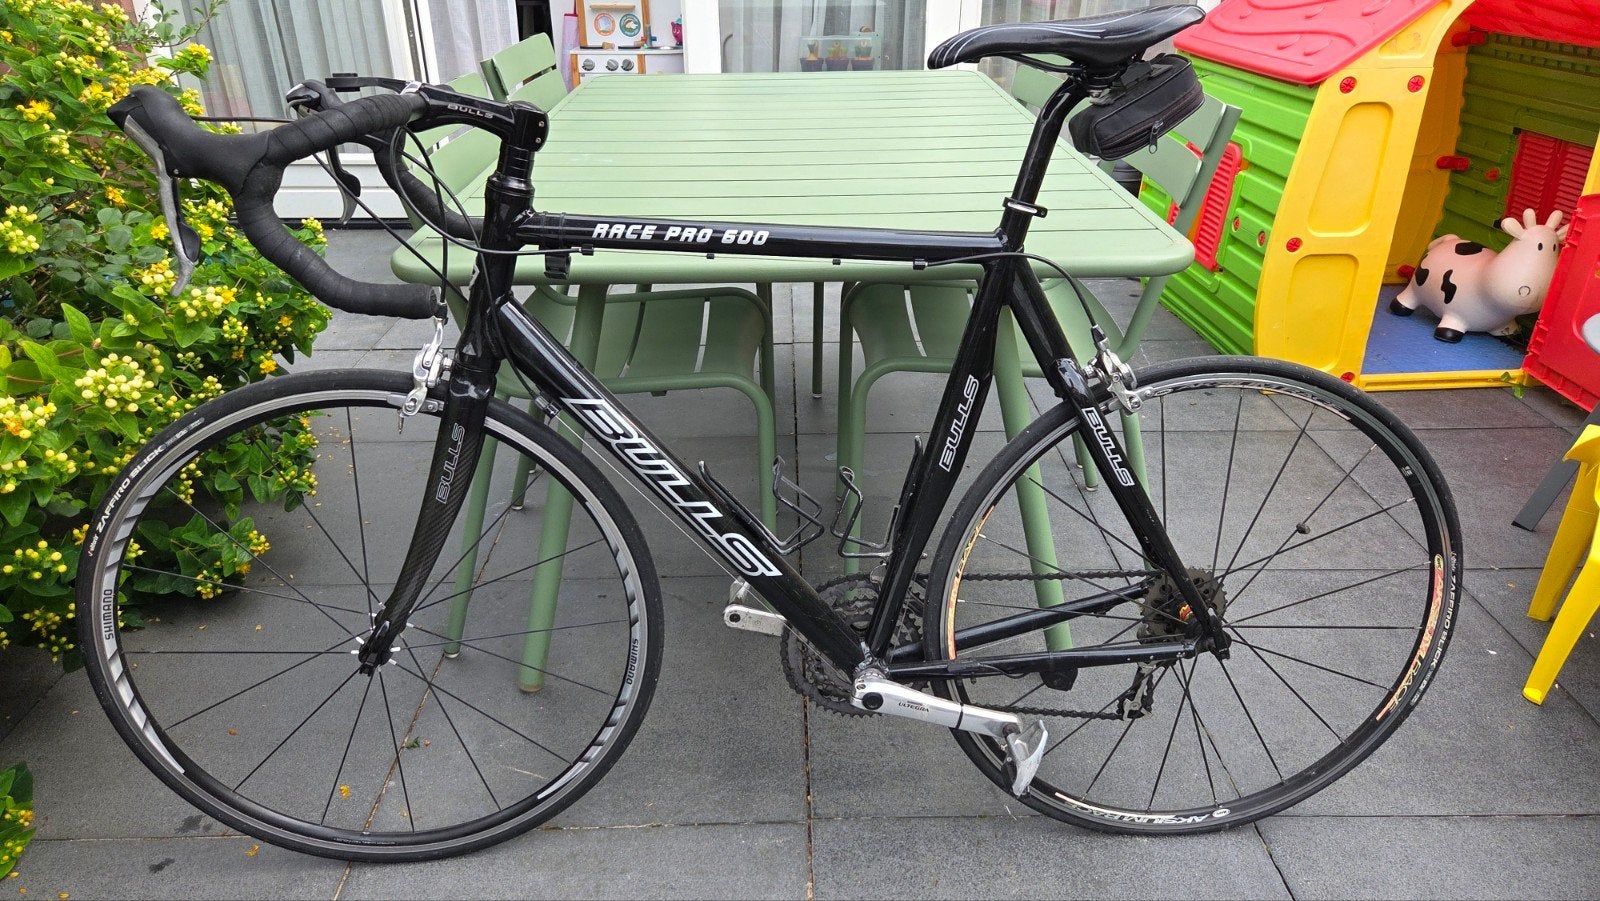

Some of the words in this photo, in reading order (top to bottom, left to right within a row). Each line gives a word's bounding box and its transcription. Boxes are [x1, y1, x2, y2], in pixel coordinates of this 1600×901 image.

[447, 103, 494, 119] BULLS
[591, 223, 658, 240] RACE
[663, 226, 714, 243] PRO
[721, 229, 770, 246] 600
[939, 374, 980, 472] BULLS
[1081, 406, 1135, 487] BULLS
[96, 477, 132, 533] ZAFFIRO
[130, 443, 167, 479] SLICK
[436, 422, 466, 504] BULLS
[559, 397, 784, 578] BULLS
[102, 589, 115, 641] SHIMANO
[1444, 575, 1456, 630] ZAFFIRO
[626, 638, 639, 685] SHIMANO
[1430, 629, 1450, 669] SLICK
